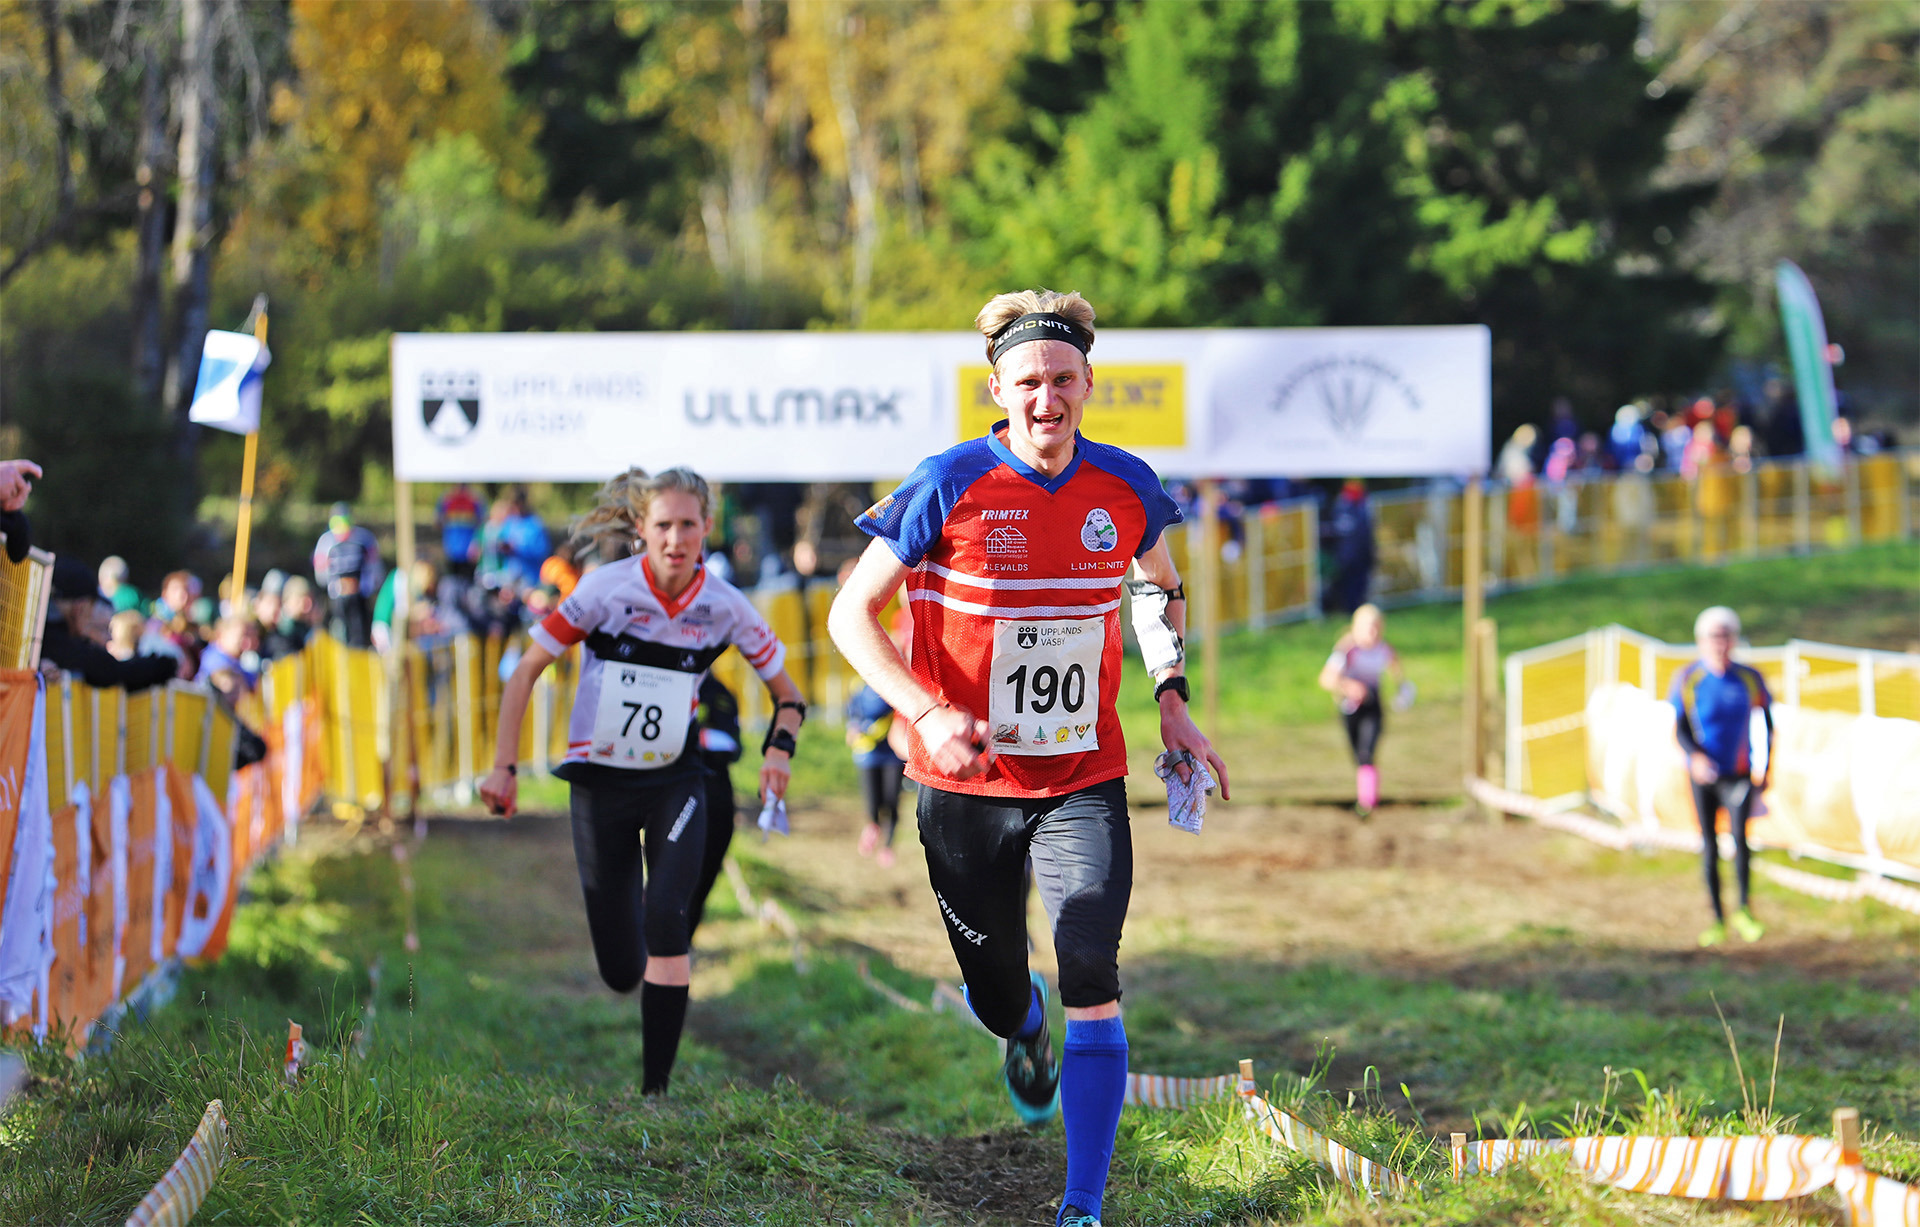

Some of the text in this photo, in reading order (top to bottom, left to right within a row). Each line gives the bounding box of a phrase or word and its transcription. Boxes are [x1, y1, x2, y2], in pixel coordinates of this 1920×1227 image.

[998, 319, 1072, 345] LUMONITE
[683, 387, 905, 427] ULLMAX
[981, 509, 1030, 520] TRIMTEX
[983, 563, 1029, 571] ALEWALDS
[1071, 560, 1125, 571] LUMONITE
[1041, 626, 1082, 636] UPPLANDS
[1006, 663, 1086, 714] 190
[621, 701, 663, 741] 78
